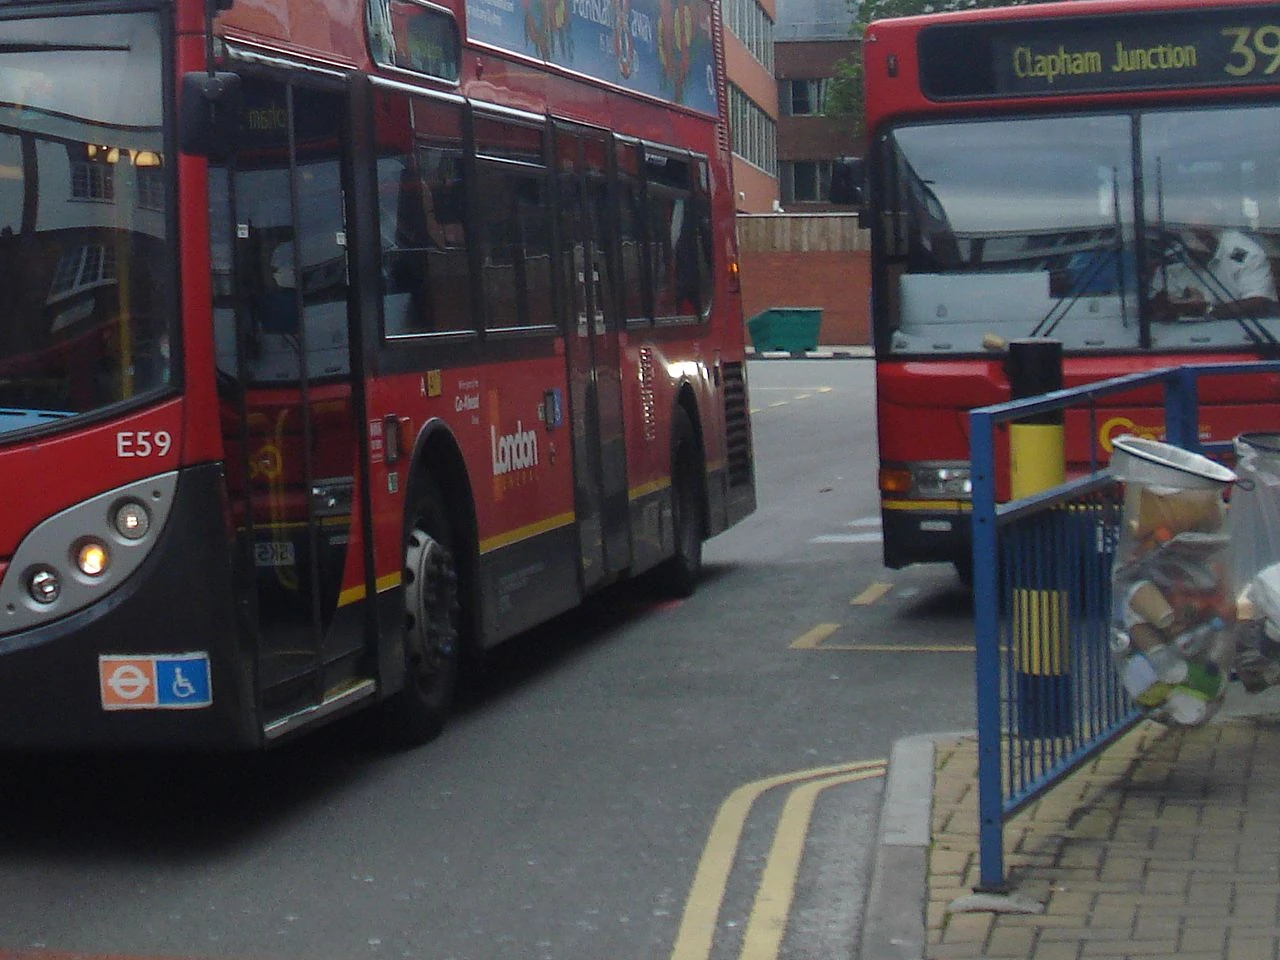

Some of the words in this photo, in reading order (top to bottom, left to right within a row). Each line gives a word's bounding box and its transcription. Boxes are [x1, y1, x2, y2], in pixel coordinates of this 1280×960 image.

[1013, 44, 1103, 84] Clapham
[1111, 41, 1198, 73] Junction
[116, 430, 172, 458] E59
[491, 420, 538, 476] London
